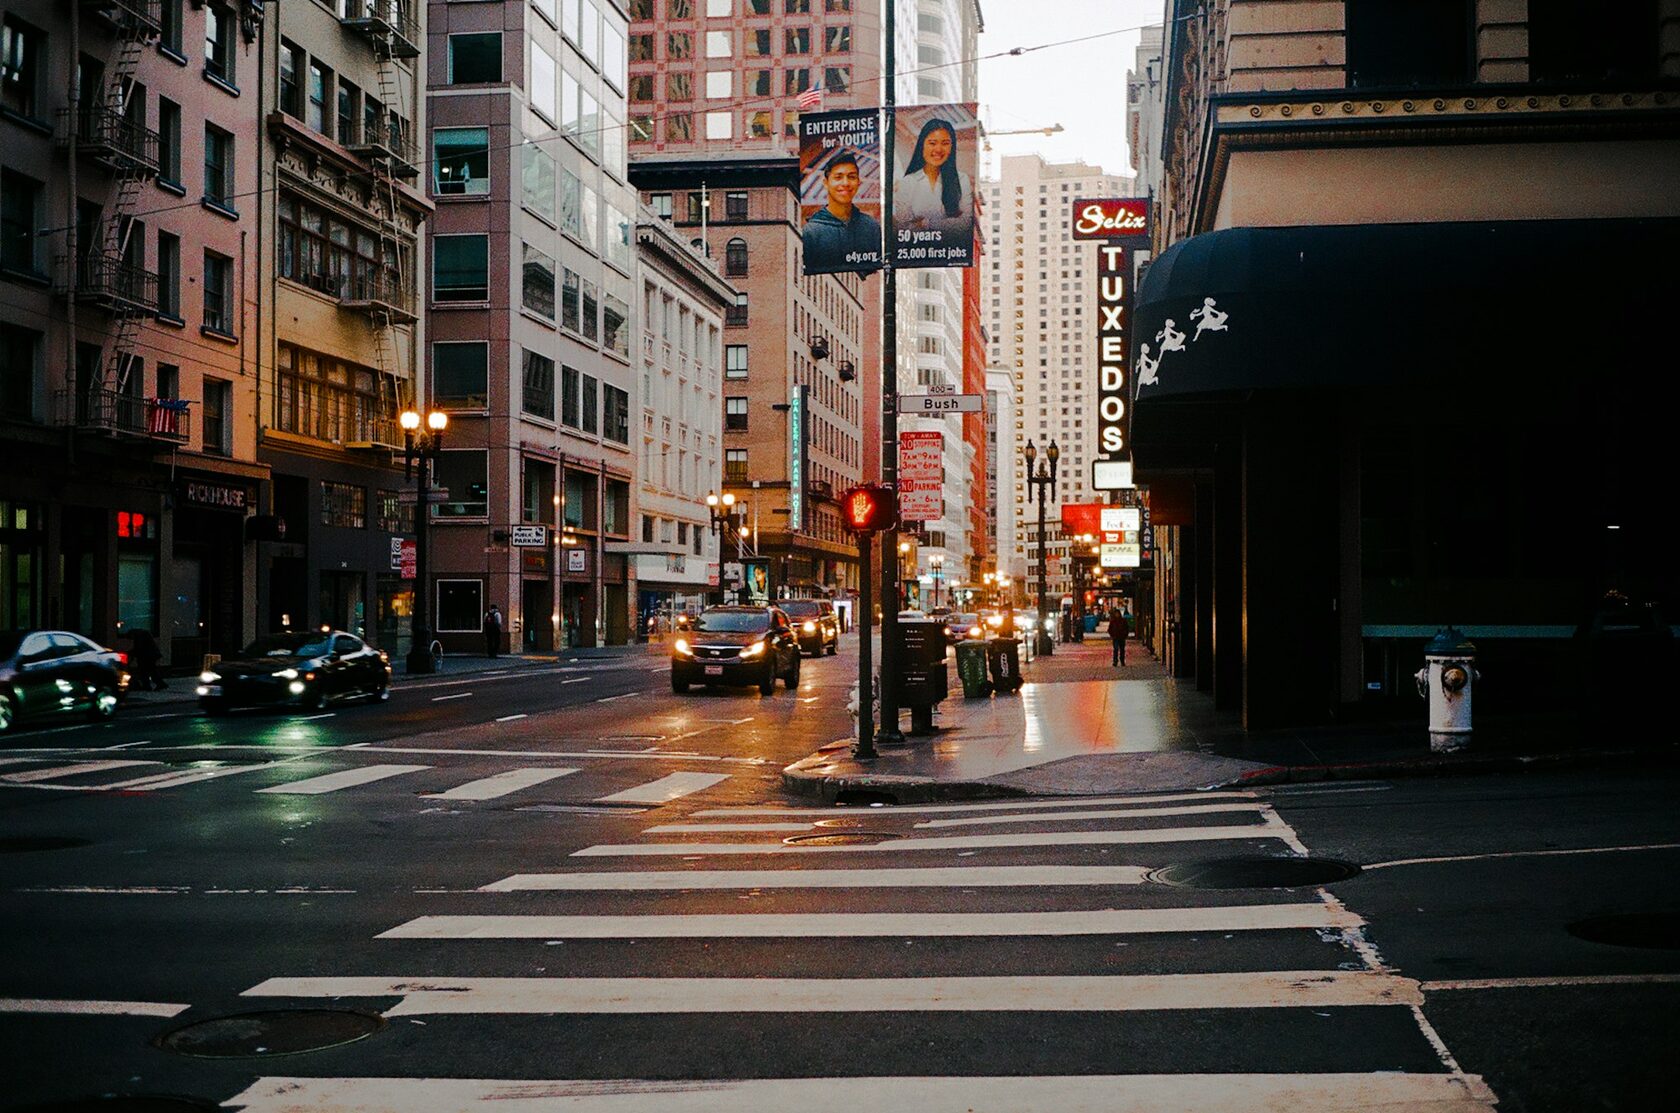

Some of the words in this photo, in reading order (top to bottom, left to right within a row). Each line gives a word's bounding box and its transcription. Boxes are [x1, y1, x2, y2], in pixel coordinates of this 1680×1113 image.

[806, 117, 874, 136] ENTERPRISE
[822, 136, 837, 149] for
[838, 132, 874, 147] YOUTH
[1075, 204, 1146, 234] Selix
[898, 230, 910, 242] 50
[913, 230, 942, 244] years
[846, 251, 878, 264] e4y.org
[897, 248, 926, 260] 25,000
[928, 247, 946, 259] first
[947, 247, 967, 260] jobs
[1100, 246, 1125, 452] TUXEDOS
[930, 385, 945, 393] 400
[924, 399, 959, 409] Bush
[901, 440, 913, 449] NO
[901, 480, 913, 491] NO
[914, 483, 940, 491] PARKING
